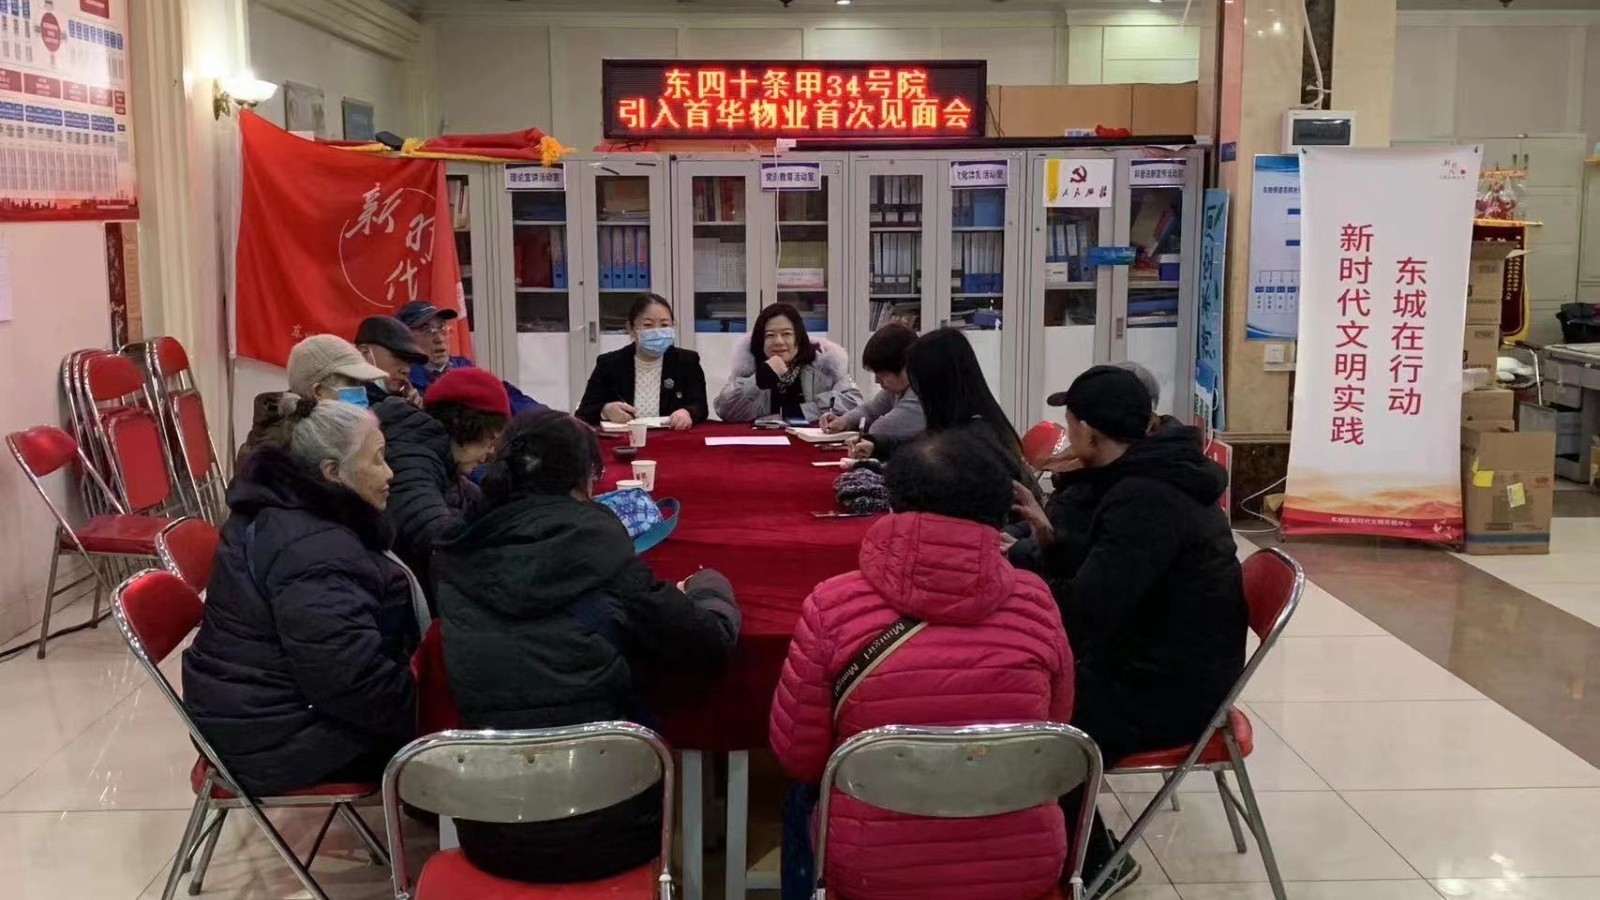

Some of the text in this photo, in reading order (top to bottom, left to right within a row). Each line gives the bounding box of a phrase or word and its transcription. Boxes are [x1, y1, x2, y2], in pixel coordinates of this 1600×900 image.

[618, 98, 972, 129] 引入首华物业首次见面会
[663, 68, 927, 99] 东四十条甲34号院
[1330, 223, 1375, 446] 新时代文明实践
[1387, 256, 1428, 416] 东城在行动
